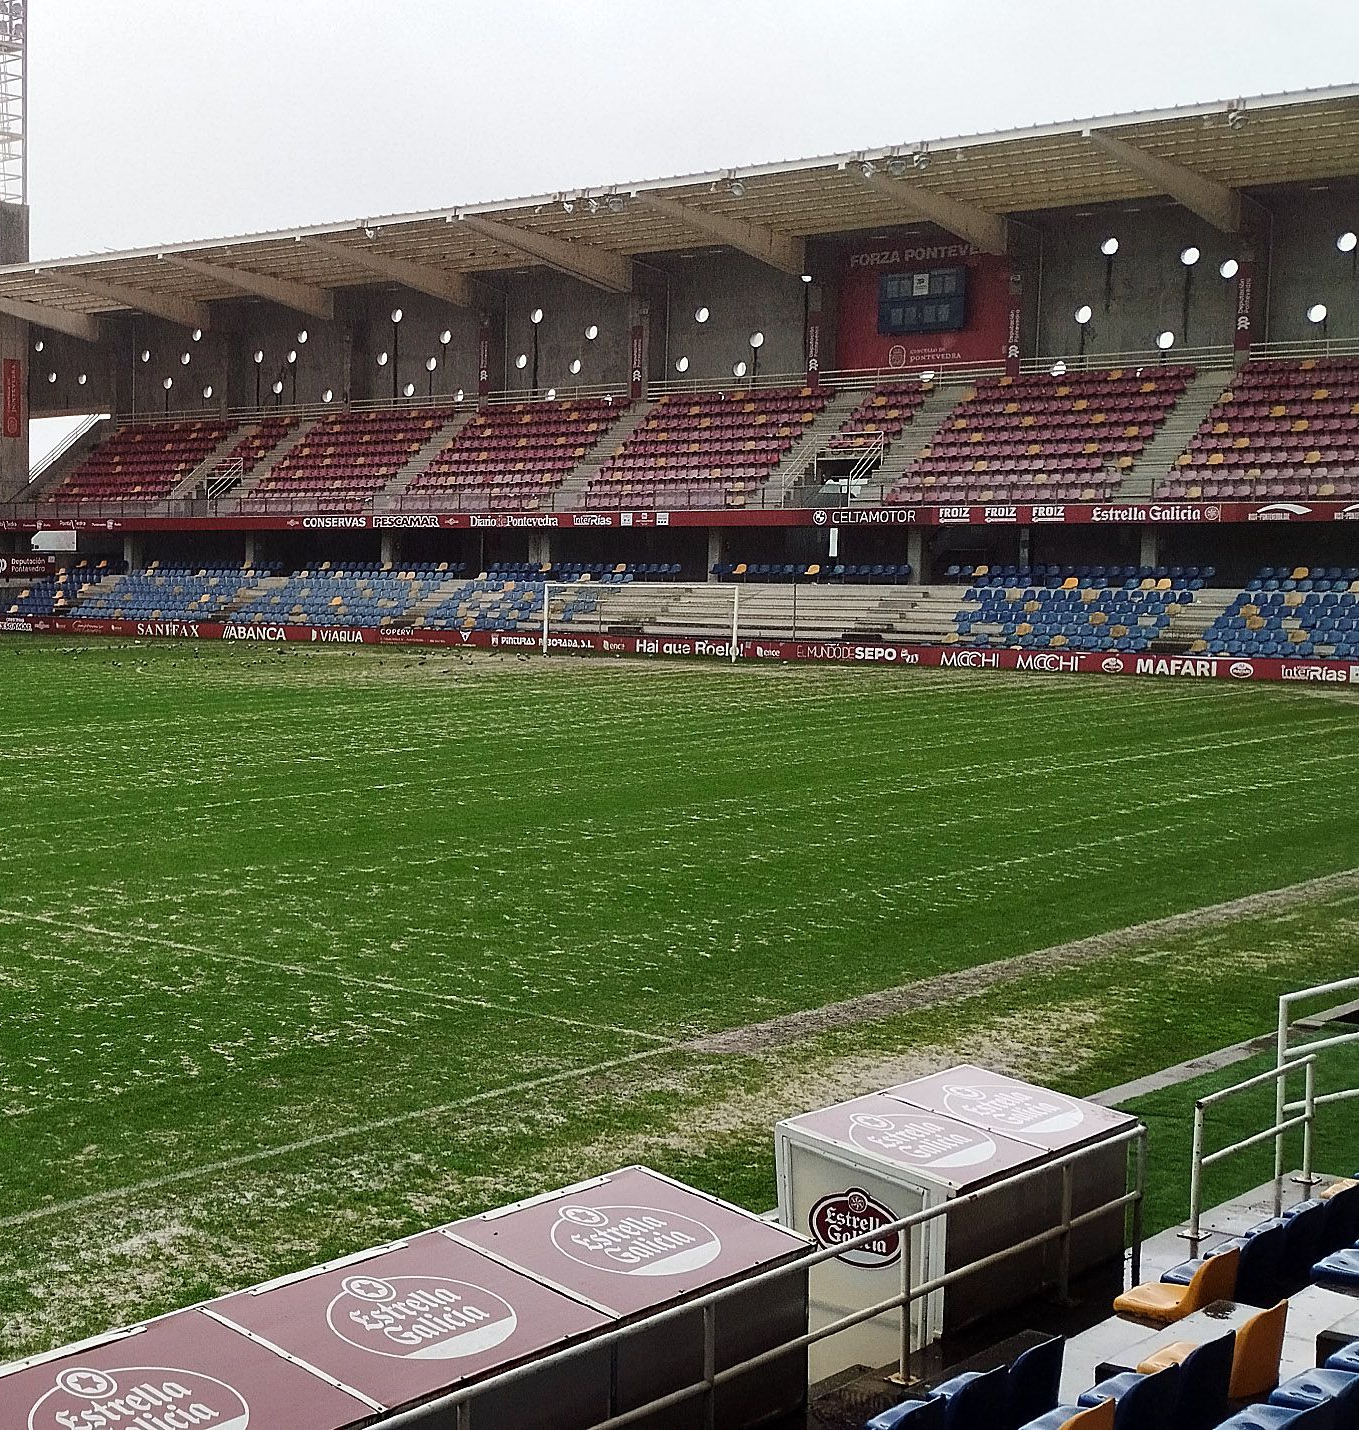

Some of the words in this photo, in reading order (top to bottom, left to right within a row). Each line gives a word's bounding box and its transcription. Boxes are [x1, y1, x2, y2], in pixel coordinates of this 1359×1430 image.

[850, 250, 901, 268] FORZA
[910, 352, 962, 362] PONTEVEDRA
[832, 510, 915, 524] CELTAMOTOR
[939, 507, 970, 518] FROIZ
[985, 507, 1016, 517] FROIZ
[1032, 506, 1065, 517] FROIZ
[1091, 506, 1146, 521] Estrella
[1149, 506, 1201, 521] Galicia
[303, 517, 366, 528] CONSERVAS
[373, 516, 440, 528] PESCAMAR
[470, 516, 497, 527] Diario
[506, 515, 559, 527] Pontevedra
[136, 623, 200, 638] SANIFAX
[228, 626, 287, 641] ABANCA
[380, 628, 414, 636] COPERVI
[636, 639, 659, 653] Hai
[663, 642, 691, 655] que
[855, 647, 897, 661] SEPO
[1136, 658, 1217, 677] MAFARI
[868, 1119, 945, 1150] Estrella
[570, 1213, 669, 1252] Estrella
[604, 1230, 696, 1265] Galicia
[349, 1285, 463, 1331] Estrella
[383, 1302, 490, 1345] Galicia
[55, 1382, 192, 1430] Estrella
